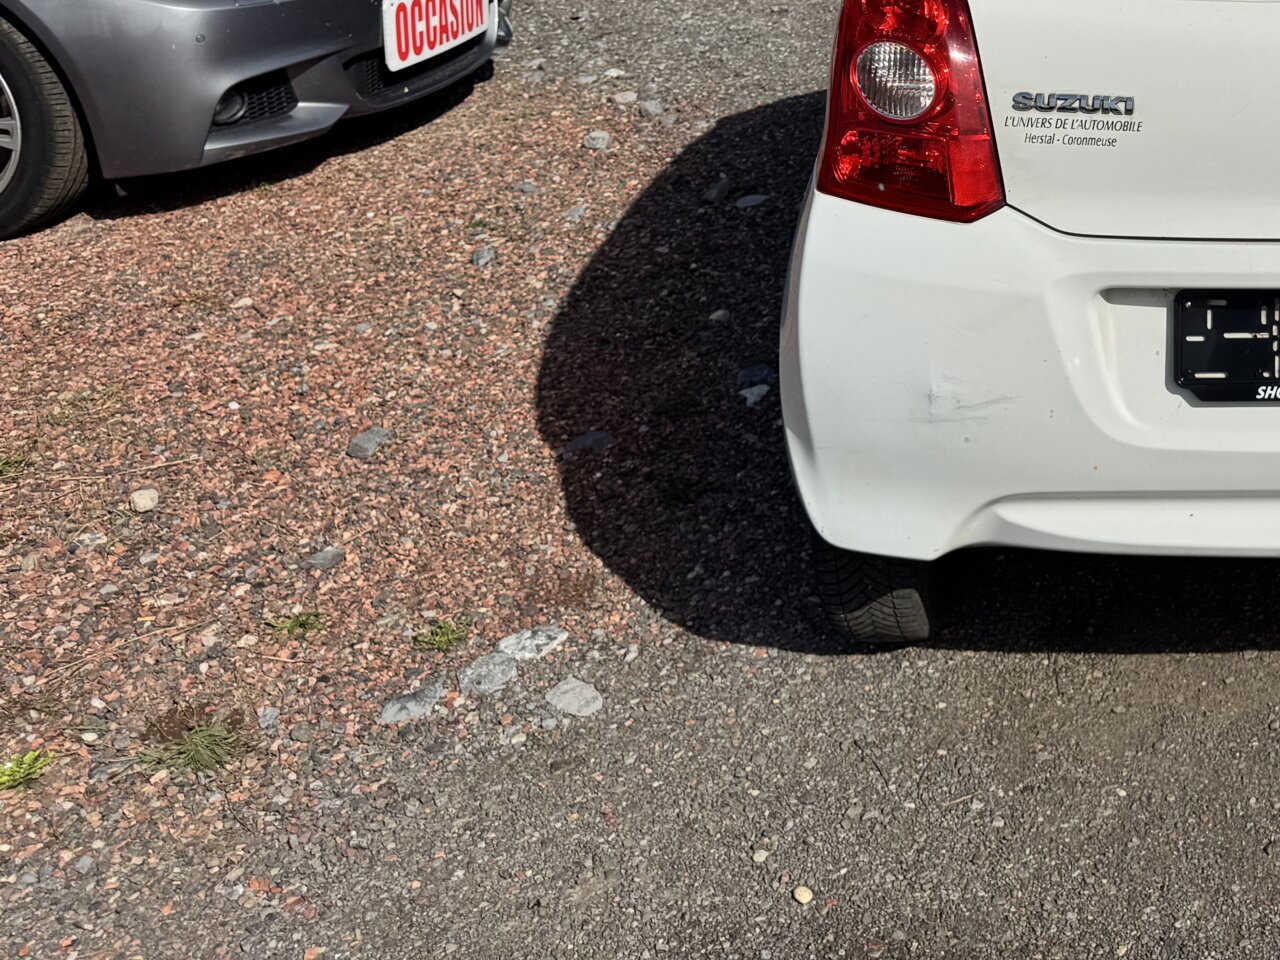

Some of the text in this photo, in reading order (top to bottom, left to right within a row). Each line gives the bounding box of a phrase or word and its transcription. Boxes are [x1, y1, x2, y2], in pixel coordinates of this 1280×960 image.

[1011, 91, 1134, 115] SUZUKI
[1004, 115, 1143, 133] L'UNIVERS DE L'AUTOMOBILE
[1024, 132, 1056, 145] Herstal
[1062, 134, 1118, 148] Coronmeuse
